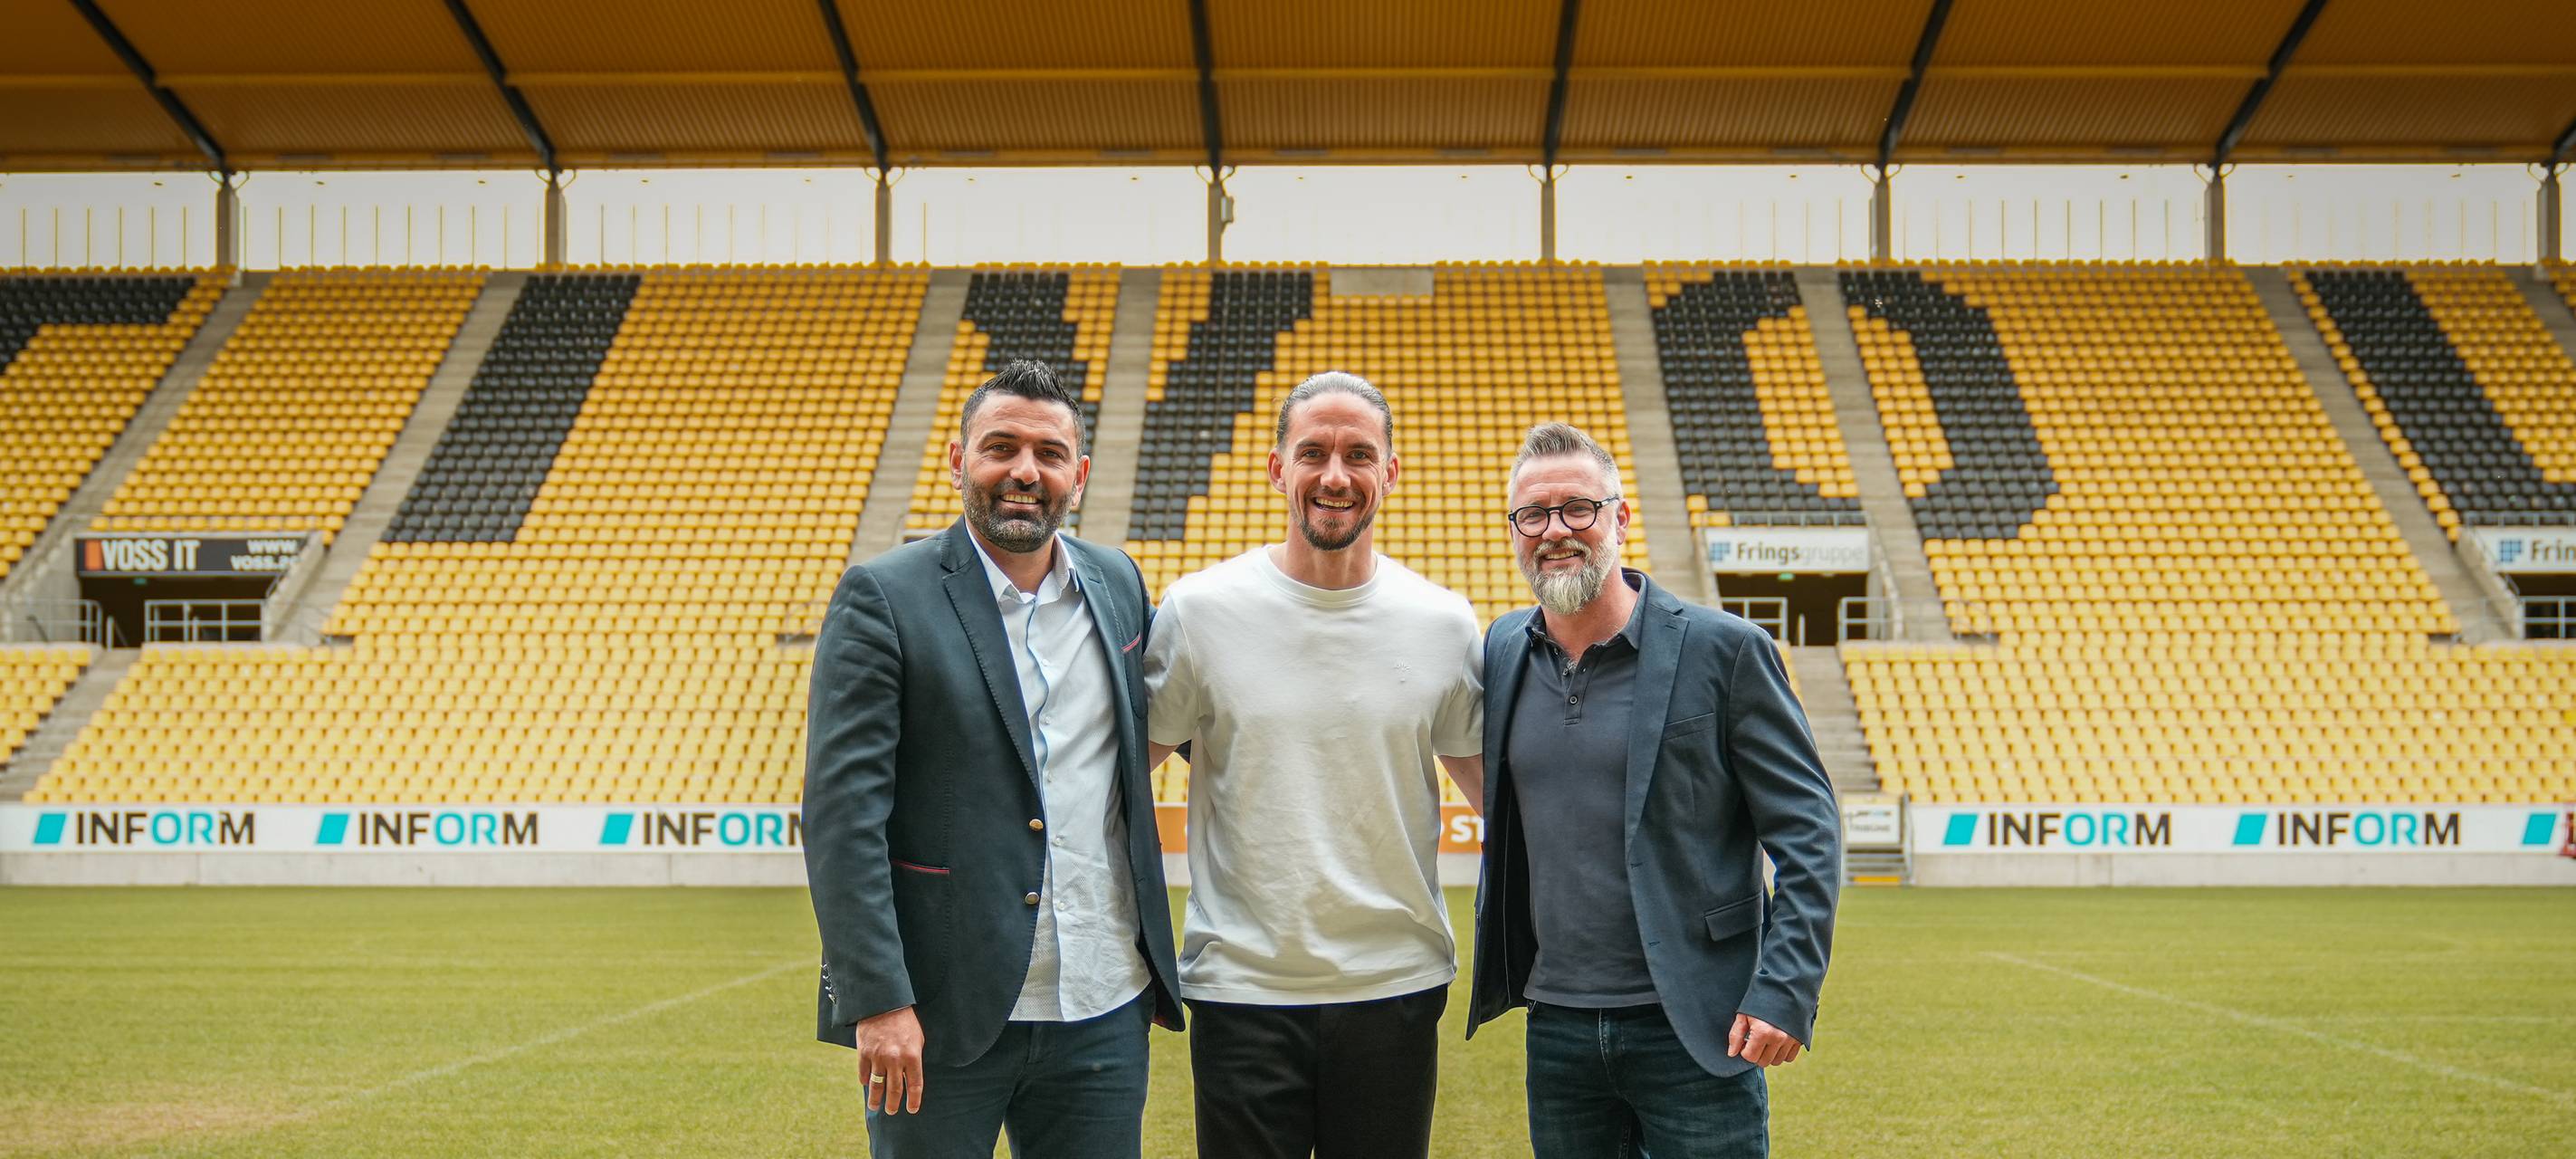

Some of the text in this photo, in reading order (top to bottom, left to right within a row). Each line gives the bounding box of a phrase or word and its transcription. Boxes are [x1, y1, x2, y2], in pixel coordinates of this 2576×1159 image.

[101, 539, 200, 570] VOSS IT
[75, 812, 255, 844] INFORM
[358, 812, 539, 845] INFORM
[1989, 812, 2171, 845] INFORM
[2277, 812, 2461, 845] INFORM
